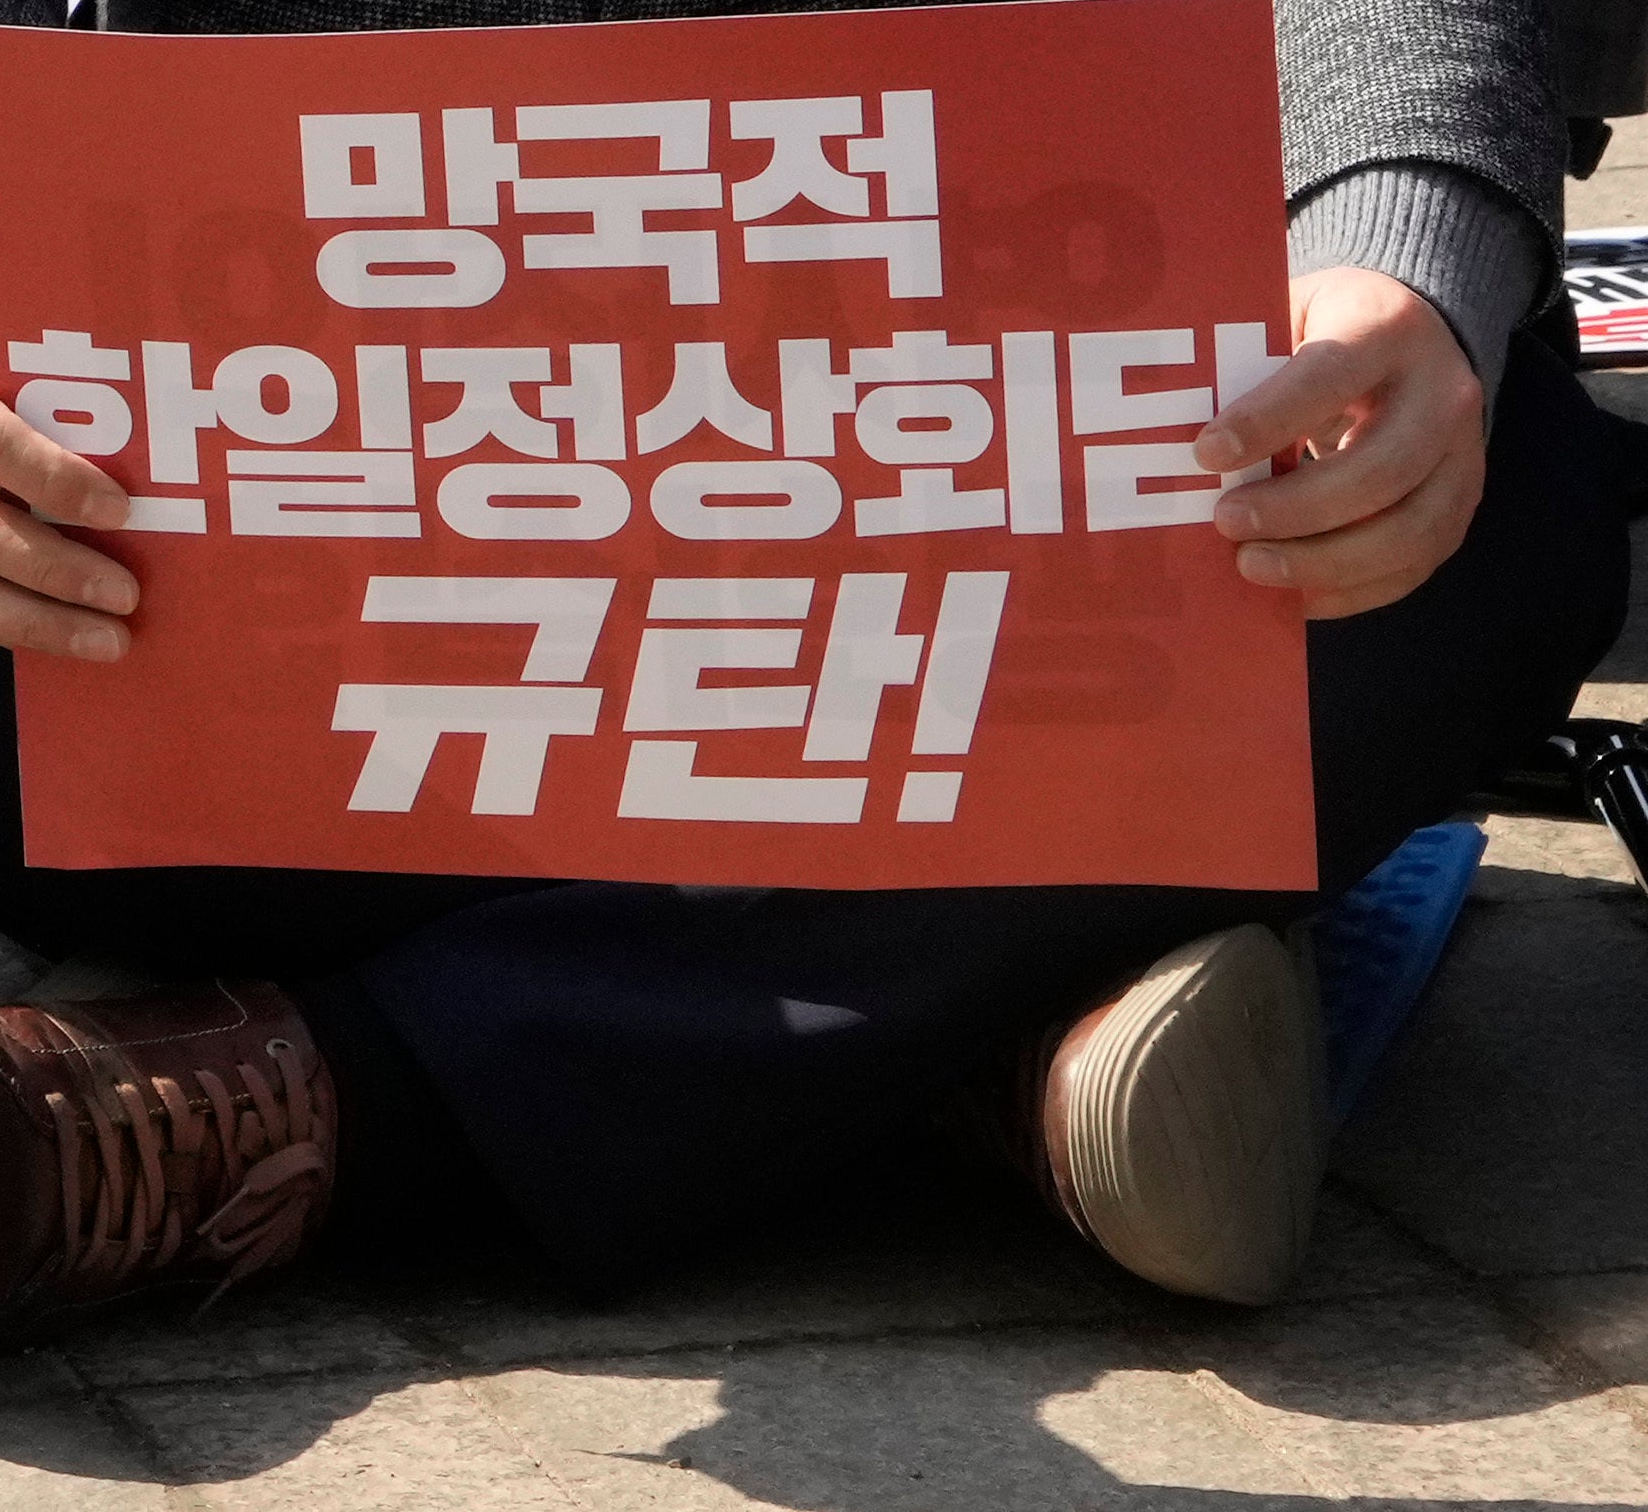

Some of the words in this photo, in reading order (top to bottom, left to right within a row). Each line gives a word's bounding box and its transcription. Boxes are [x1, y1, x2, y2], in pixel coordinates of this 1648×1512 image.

[298, 89, 944, 308] 망국적
[8, 321, 1294, 543] 한일정상회담
[329, 570, 1010, 824] 규탄!
